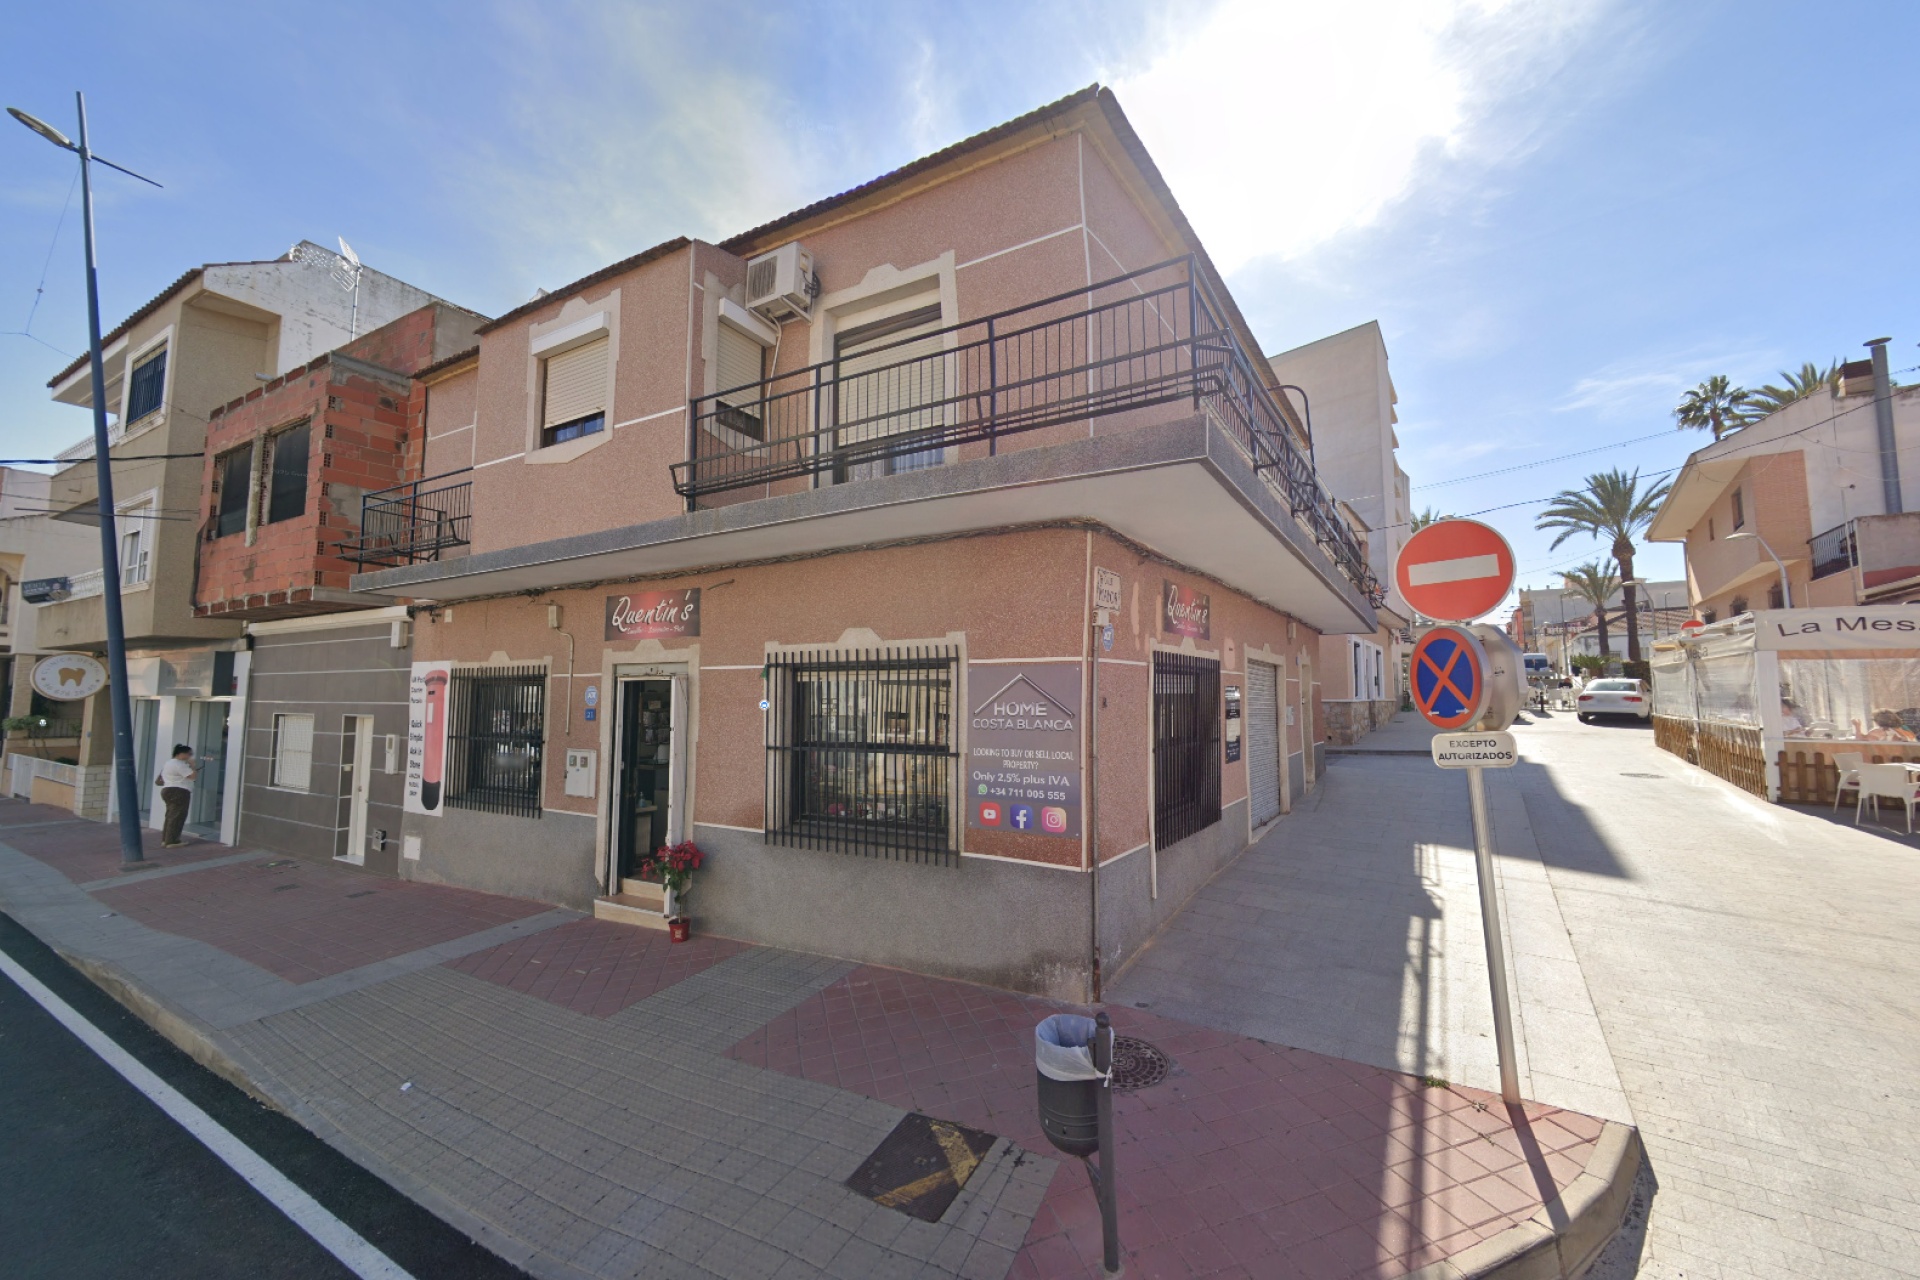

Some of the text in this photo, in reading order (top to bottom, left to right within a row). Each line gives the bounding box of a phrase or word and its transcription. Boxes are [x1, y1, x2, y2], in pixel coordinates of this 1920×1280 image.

[612, 590, 694, 632] Quentin's
[1168, 585, 1208, 625] Quentin's
[1777, 616, 1920, 637] La Mes
[994, 702, 1048, 717] HOME
[973, 718, 1074, 732] COSTA BLANCA
[1449, 739, 1497, 748] EXCEPTO
[973, 747, 1074, 760] LOOKING TO BUY OR SELL LOCAL
[1438, 752, 1513, 760] AUTORIZADOS
[1003, 760, 1039, 770] PROPERTY?
[973, 771, 1070, 787] Only 2.5% plus IVA
[990, 787, 1066, 800] +34 711 005 555
